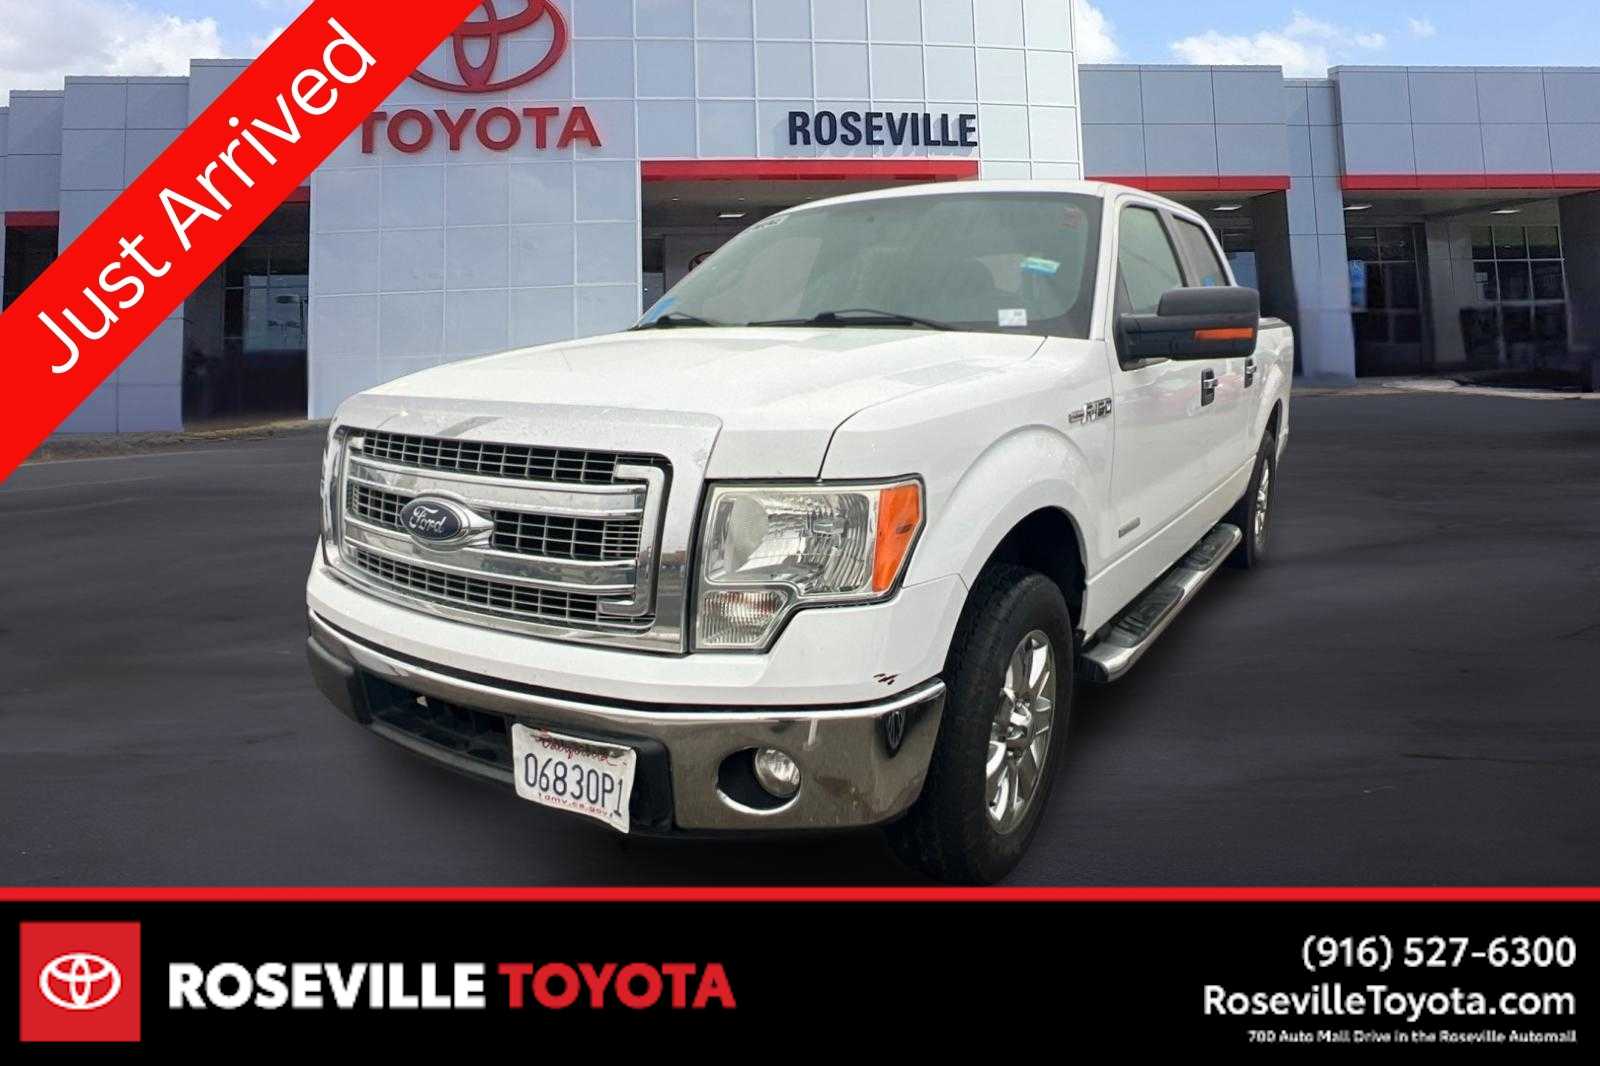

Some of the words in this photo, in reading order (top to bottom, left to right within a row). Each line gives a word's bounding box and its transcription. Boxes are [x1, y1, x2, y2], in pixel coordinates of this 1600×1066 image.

[360, 106, 602, 154] TOYOTA
[788, 110, 978, 147] ROSEVILLE
[409, 505, 447, 533] Ford
[524, 752, 623, 818] 06830P1
